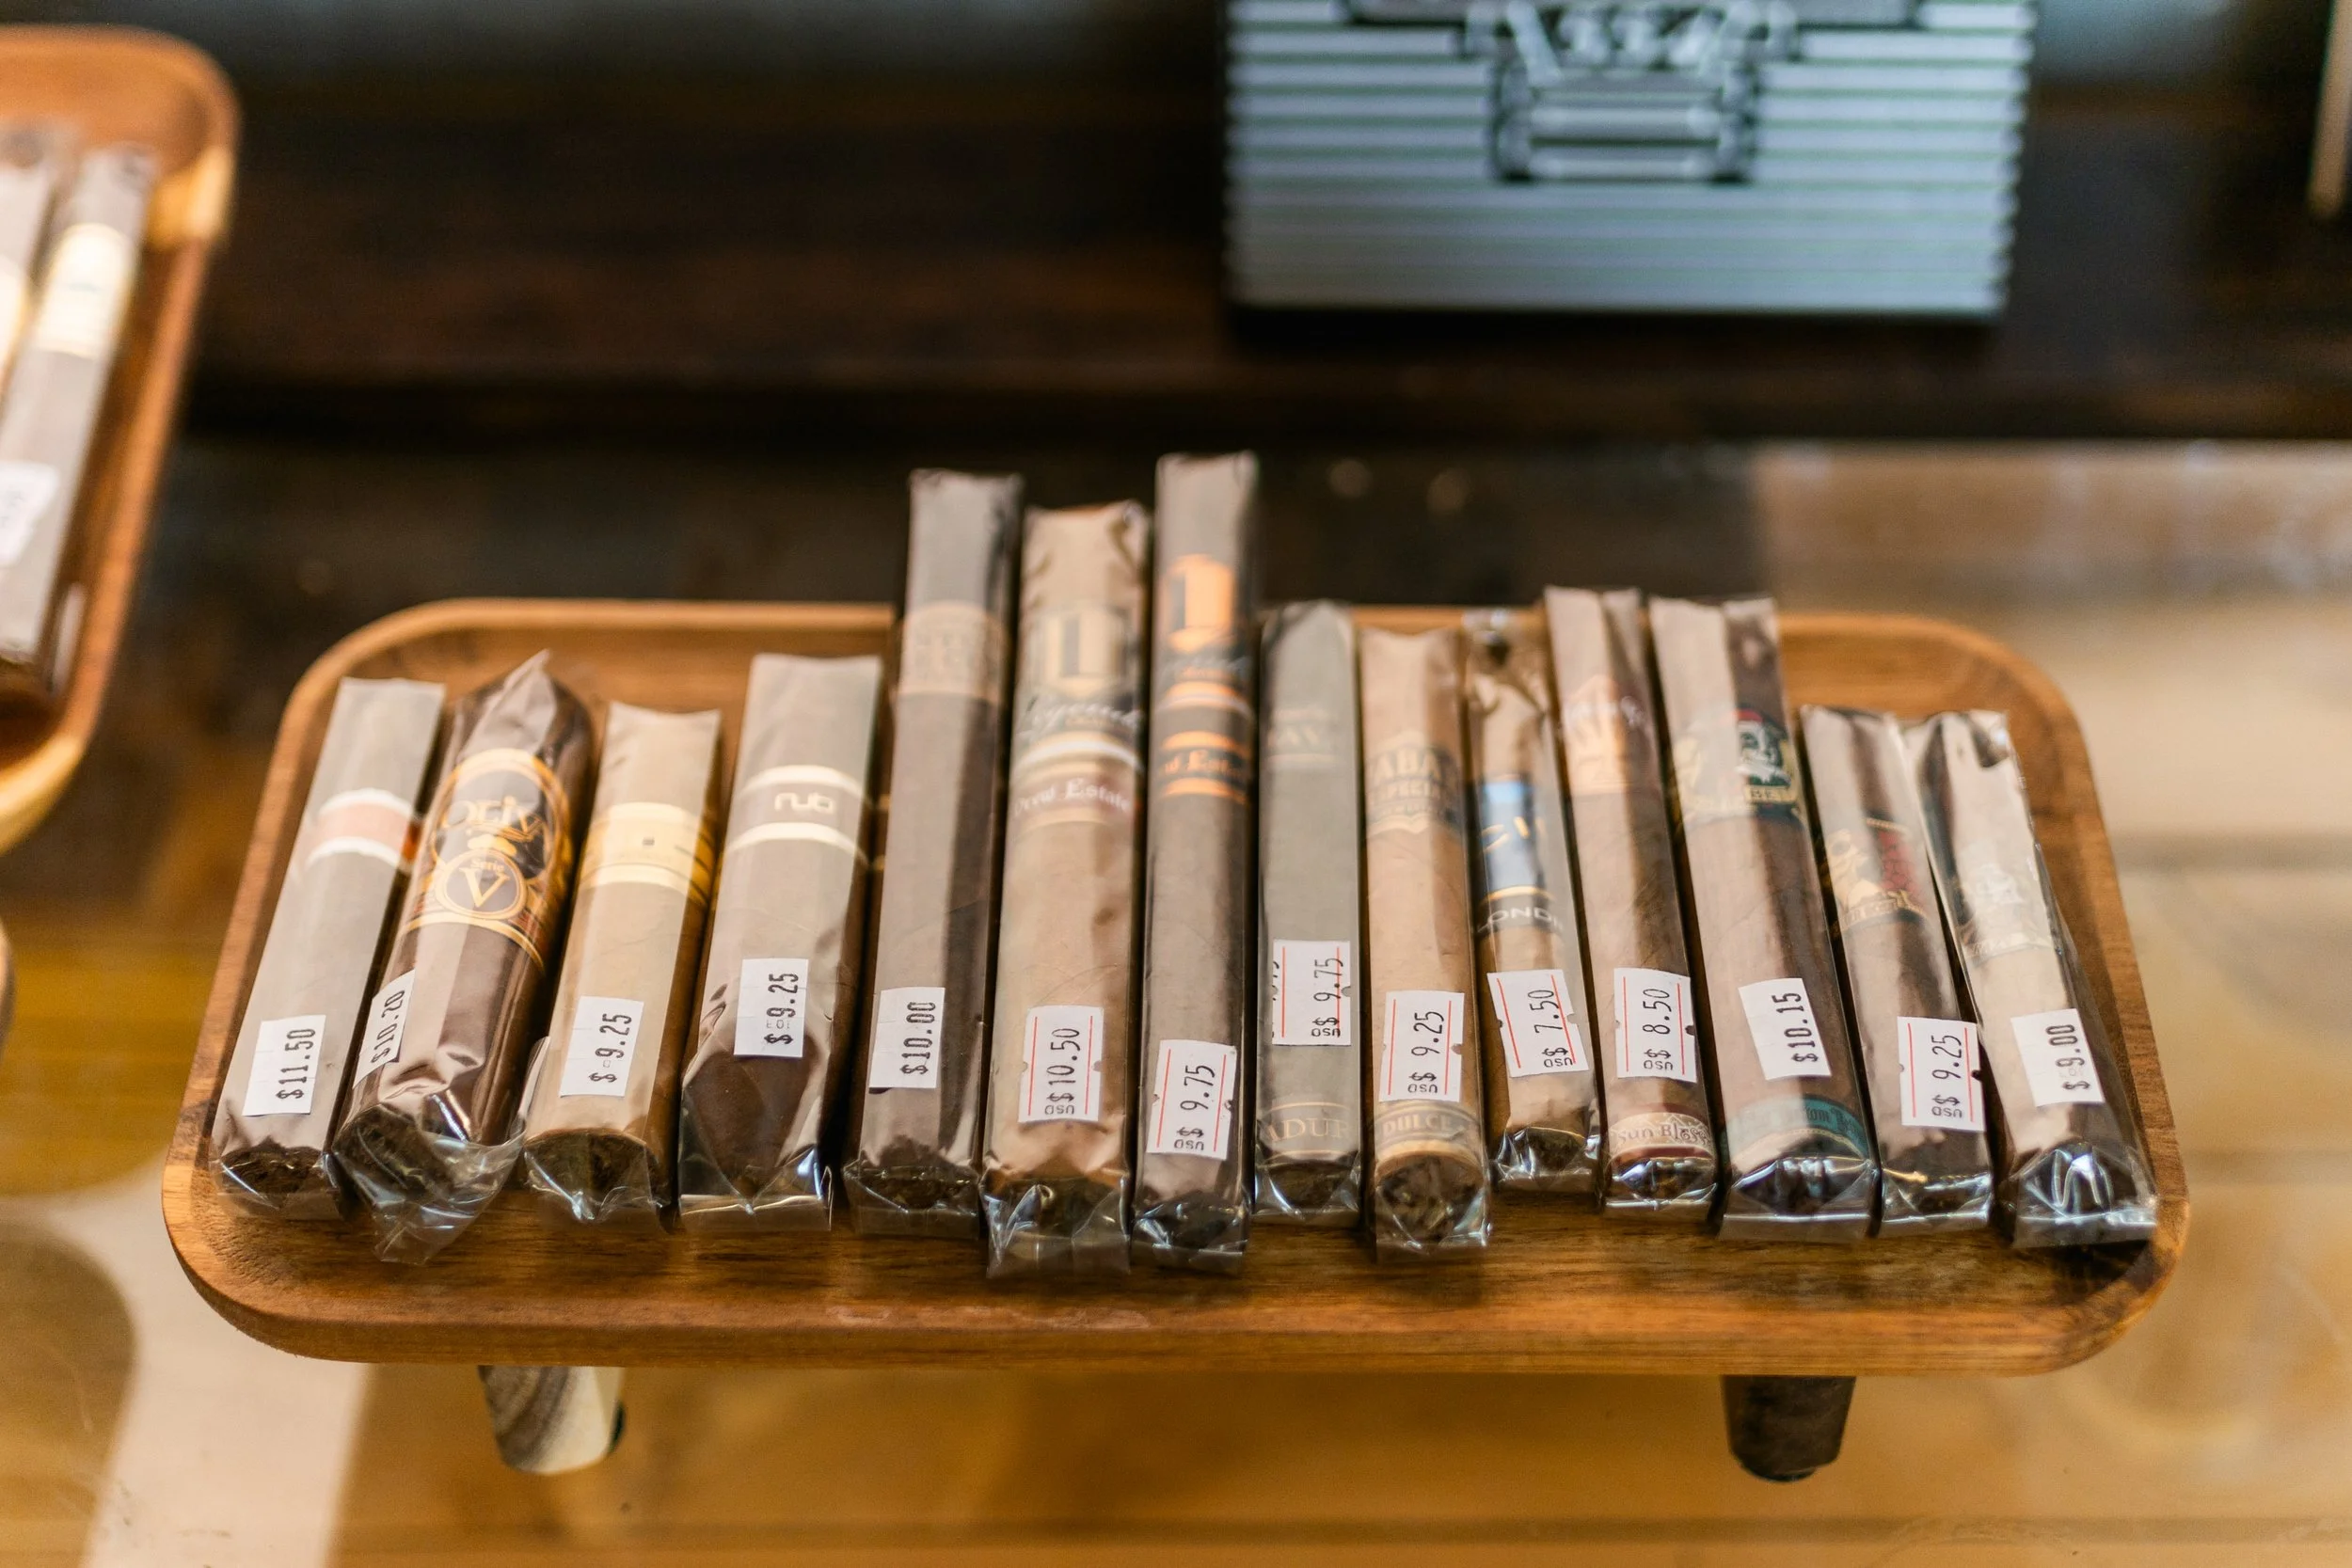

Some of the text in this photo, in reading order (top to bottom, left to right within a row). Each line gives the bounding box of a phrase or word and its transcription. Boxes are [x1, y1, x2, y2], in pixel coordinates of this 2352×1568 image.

[774, 791, 835, 815] nub
[459, 866, 510, 908] V
[470, 858, 505, 873] Serie
[1313, 958, 1343, 1002] 9.75
[371, 990, 405, 1064] $10.20
[1411, 1011, 1444, 1055] 9.25
[1527, 990, 1564, 1035] 7.50
[1643, 989, 1672, 1035] 8.50
[1772, 991, 1819, 1063] $10.15
[899, 1002, 935, 1074] $10.00
[1931, 1036, 1962, 1079] 9.25
[276, 1028, 315, 1100] $11.50
[1047, 1029, 1080, 1102] $10.50
[1180, 1066, 1216, 1110] 9.75
[1382, 1113, 1452, 1135] DULCE
